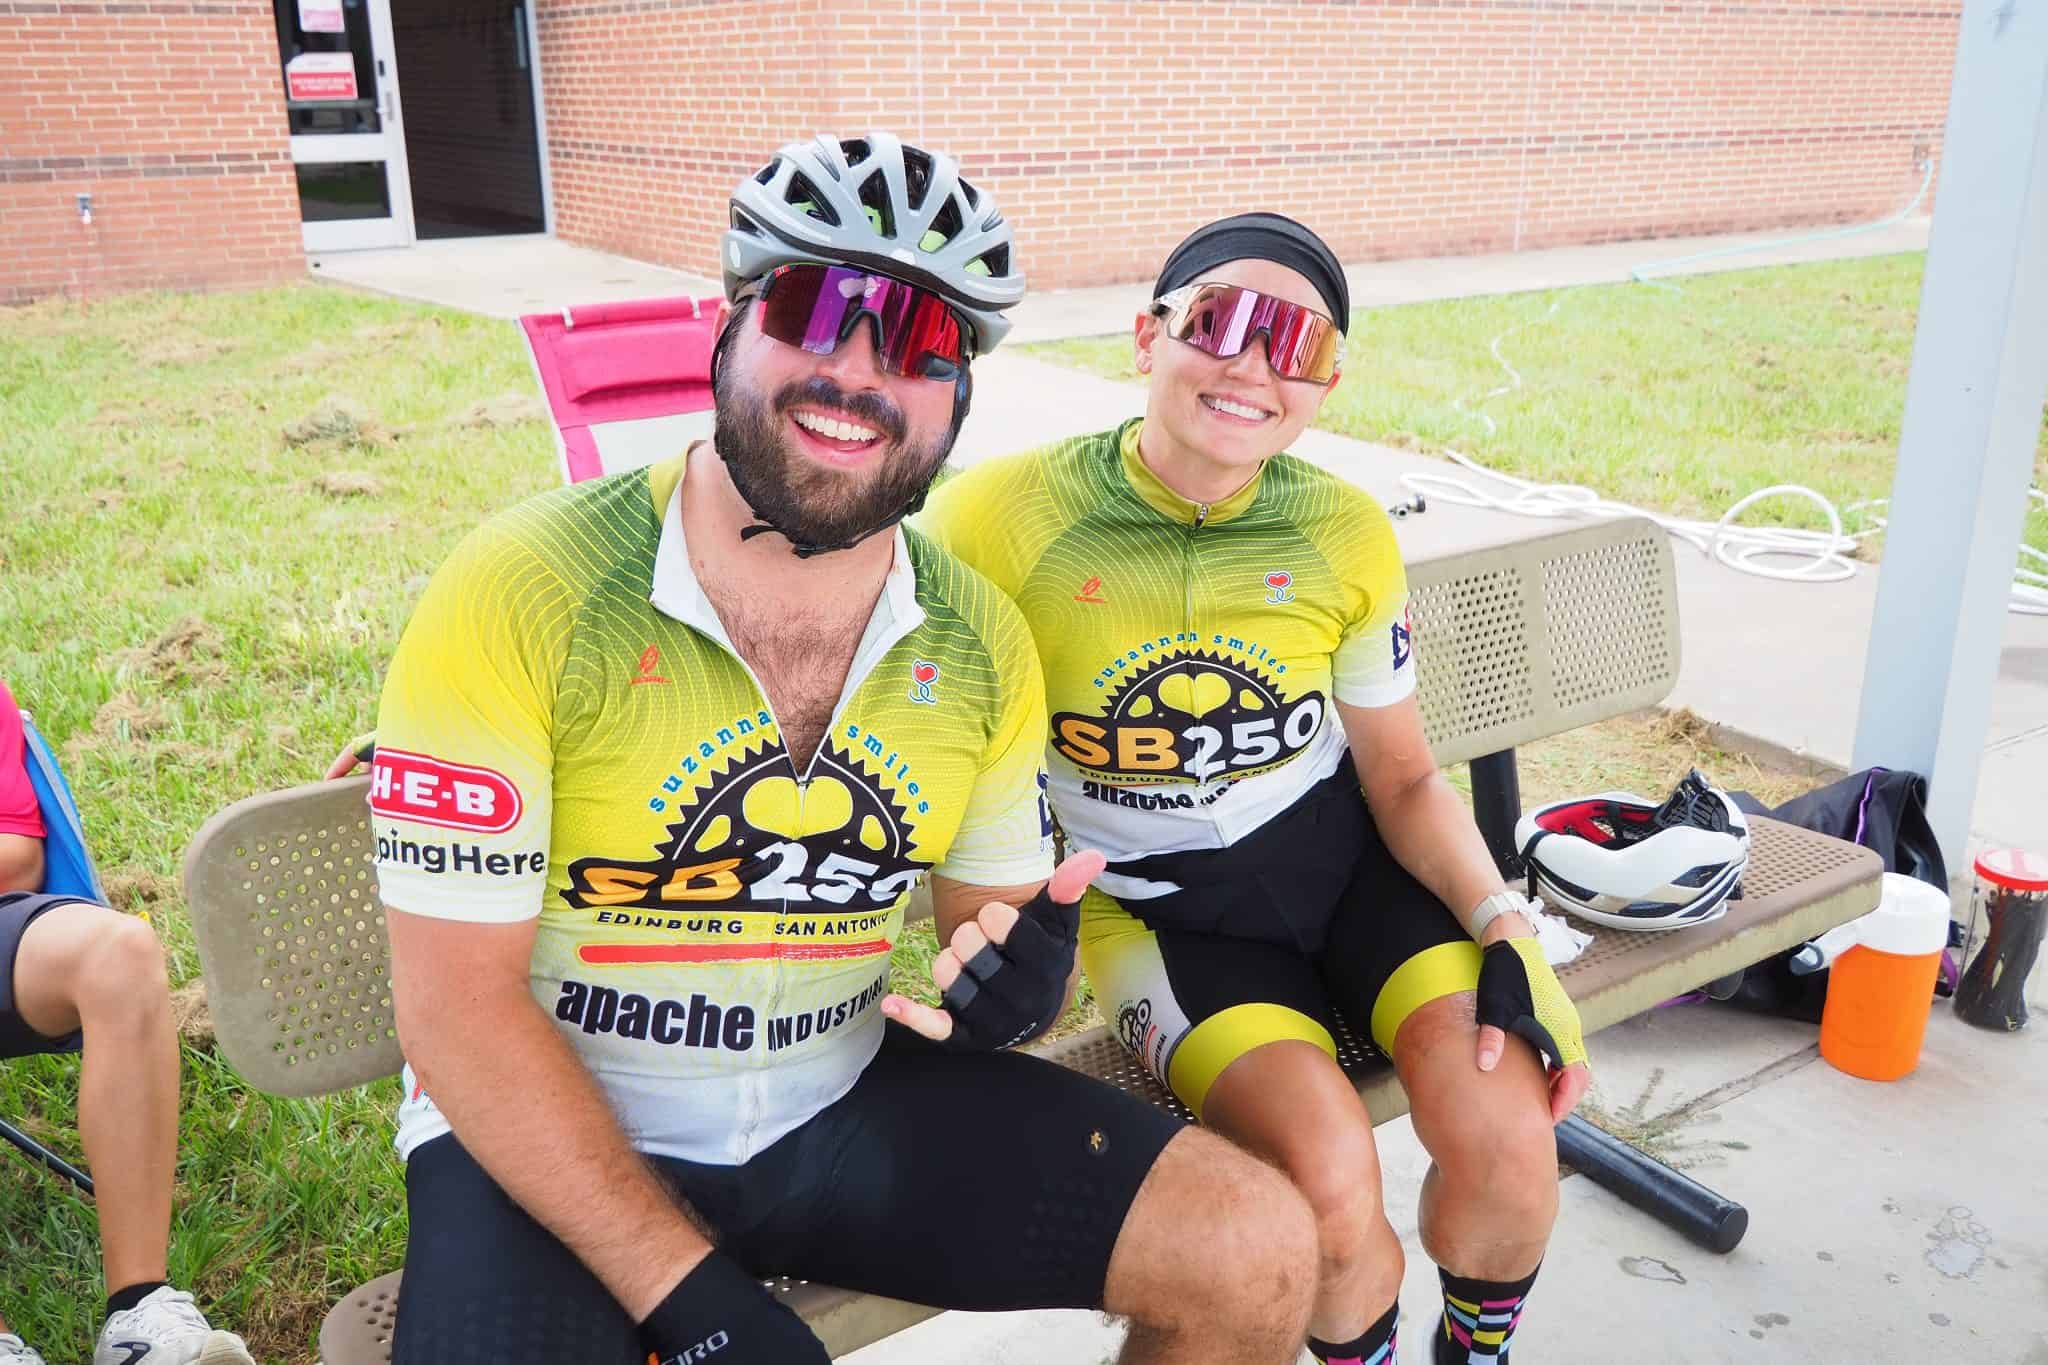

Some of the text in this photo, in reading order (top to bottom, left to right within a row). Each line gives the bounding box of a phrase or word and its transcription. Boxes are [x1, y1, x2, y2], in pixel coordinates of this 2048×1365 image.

[1213, 634, 1287, 674] smiles
[1059, 698, 1324, 776] SB250
[847, 725, 929, 814] smiles
[596, 911, 743, 934] EDINBURG
[774, 921, 817, 936] SAN
[555, 980, 755, 1052] apache
[660, 1330, 729, 1365] IRO
